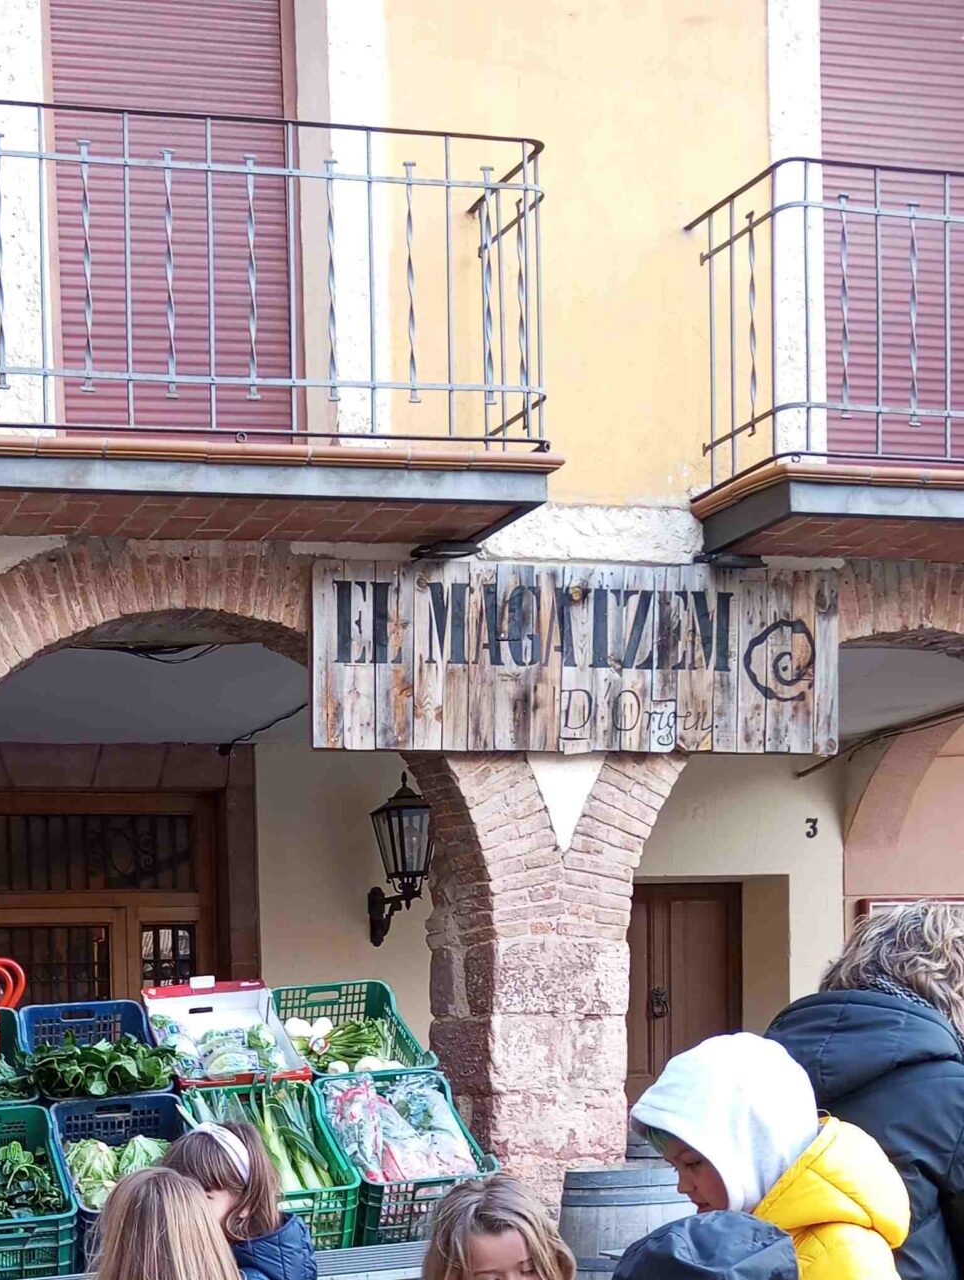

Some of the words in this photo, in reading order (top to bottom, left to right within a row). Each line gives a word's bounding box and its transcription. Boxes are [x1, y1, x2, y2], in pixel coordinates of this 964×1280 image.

[332, 580, 402, 664] EL
[424, 581, 734, 672] MAGATZEM
[805, 818, 819, 839] 3
